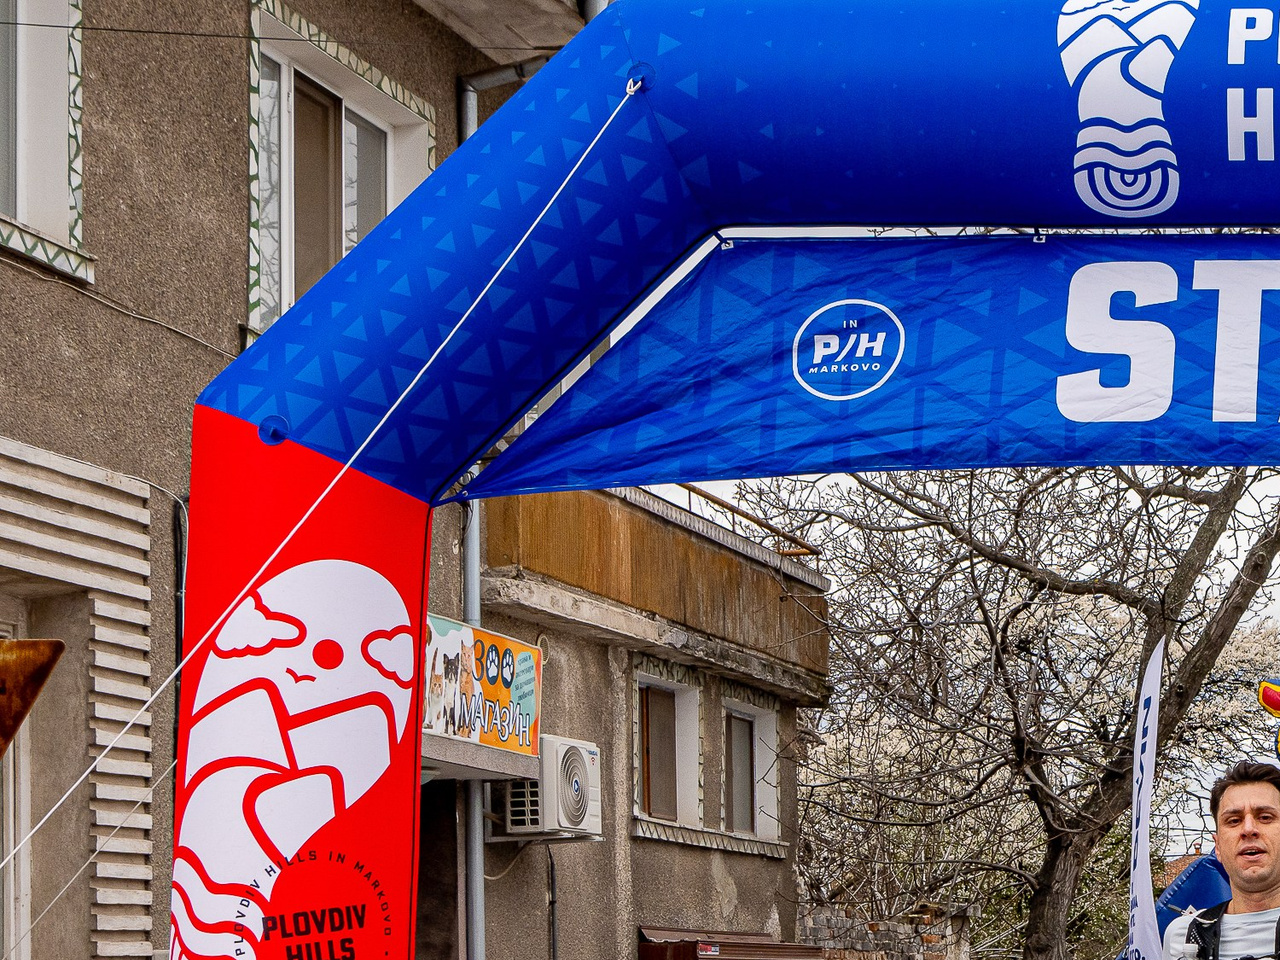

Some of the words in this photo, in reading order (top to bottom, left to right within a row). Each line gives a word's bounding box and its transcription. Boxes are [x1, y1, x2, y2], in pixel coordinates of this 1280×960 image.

[843, 319, 858, 328] IN
[812, 332, 887, 364] P/H
[808, 362, 881, 374] MARKOVO
[460, 692, 531, 747] МАГАЗИН
[264, 850, 317, 877] HILLS
[328, 851, 346, 864] IN
[353, 861, 392, 936] MARKOVO
[262, 904, 366, 941] PLOVDIV
